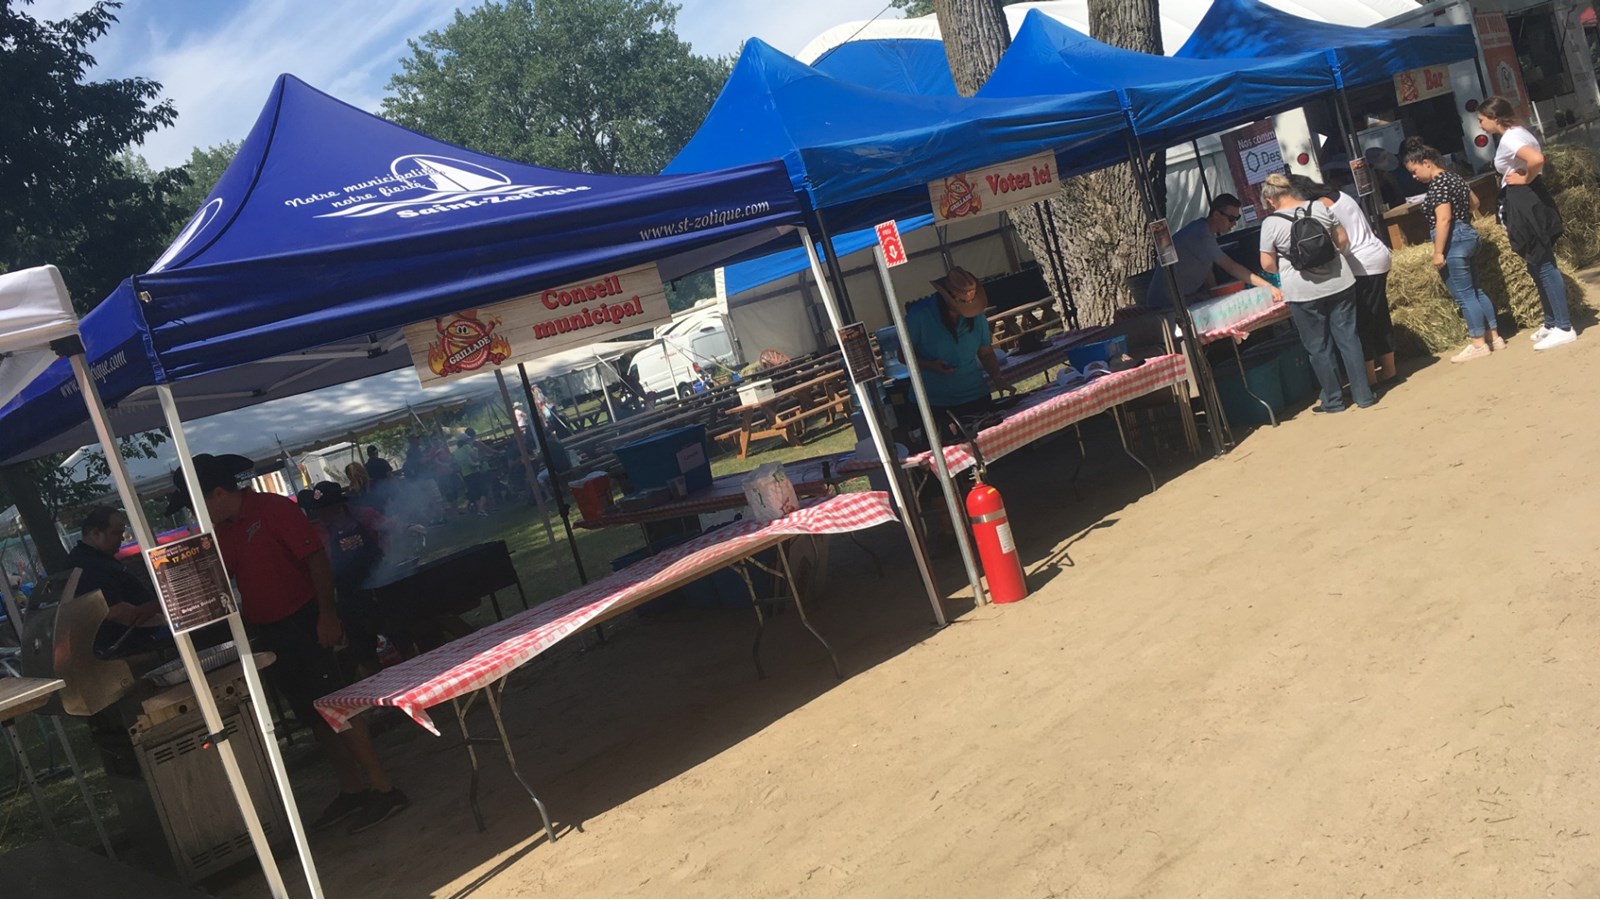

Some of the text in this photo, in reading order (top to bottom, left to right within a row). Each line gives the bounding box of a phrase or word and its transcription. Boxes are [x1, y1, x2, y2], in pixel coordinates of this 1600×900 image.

[1424, 69, 1443, 90] Bar
[1238, 138, 1252, 150] Nos
[331, 179, 427, 208] notre fierté
[985, 163, 1053, 196] Votez ici
[284, 189, 341, 208] Notre
[396, 184, 592, 219] Saint-Zotique
[639, 200, 771, 241] www.st-zotique.com
[540, 274, 624, 311] Conseil
[532, 295, 644, 341] municipal
[449, 336, 491, 366] GRILLADE
[171, 556, 179, 564] 17
